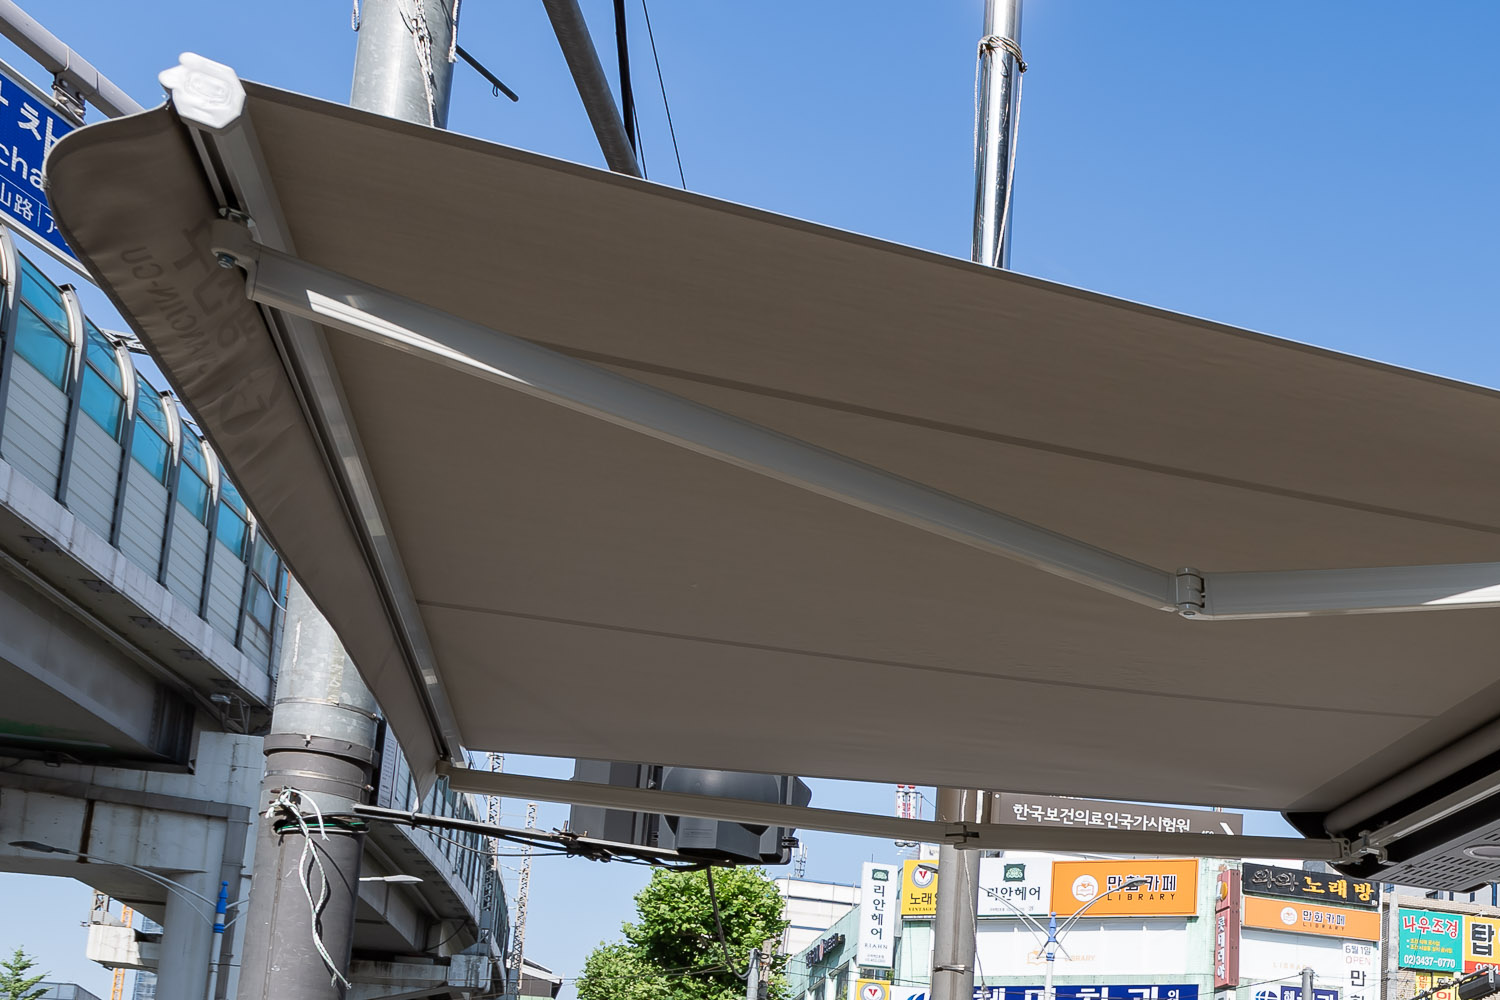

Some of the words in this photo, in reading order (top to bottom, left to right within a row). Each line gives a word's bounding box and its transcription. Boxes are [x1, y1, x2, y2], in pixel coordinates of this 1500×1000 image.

[1013, 803, 1190, 833] 한국보건의료인국가시험원
[987, 886, 1041, 901] 리안헤어
[1302, 875, 1375, 901] 노래방
[871, 885, 886, 940] 리안헤어
[1302, 910, 1346, 925] 만화카페
[1403, 916, 1459, 938] 나우조경
[1346, 956, 1371, 966] OPEN
[1404, 954, 1456, 968] 02)3437-0770
